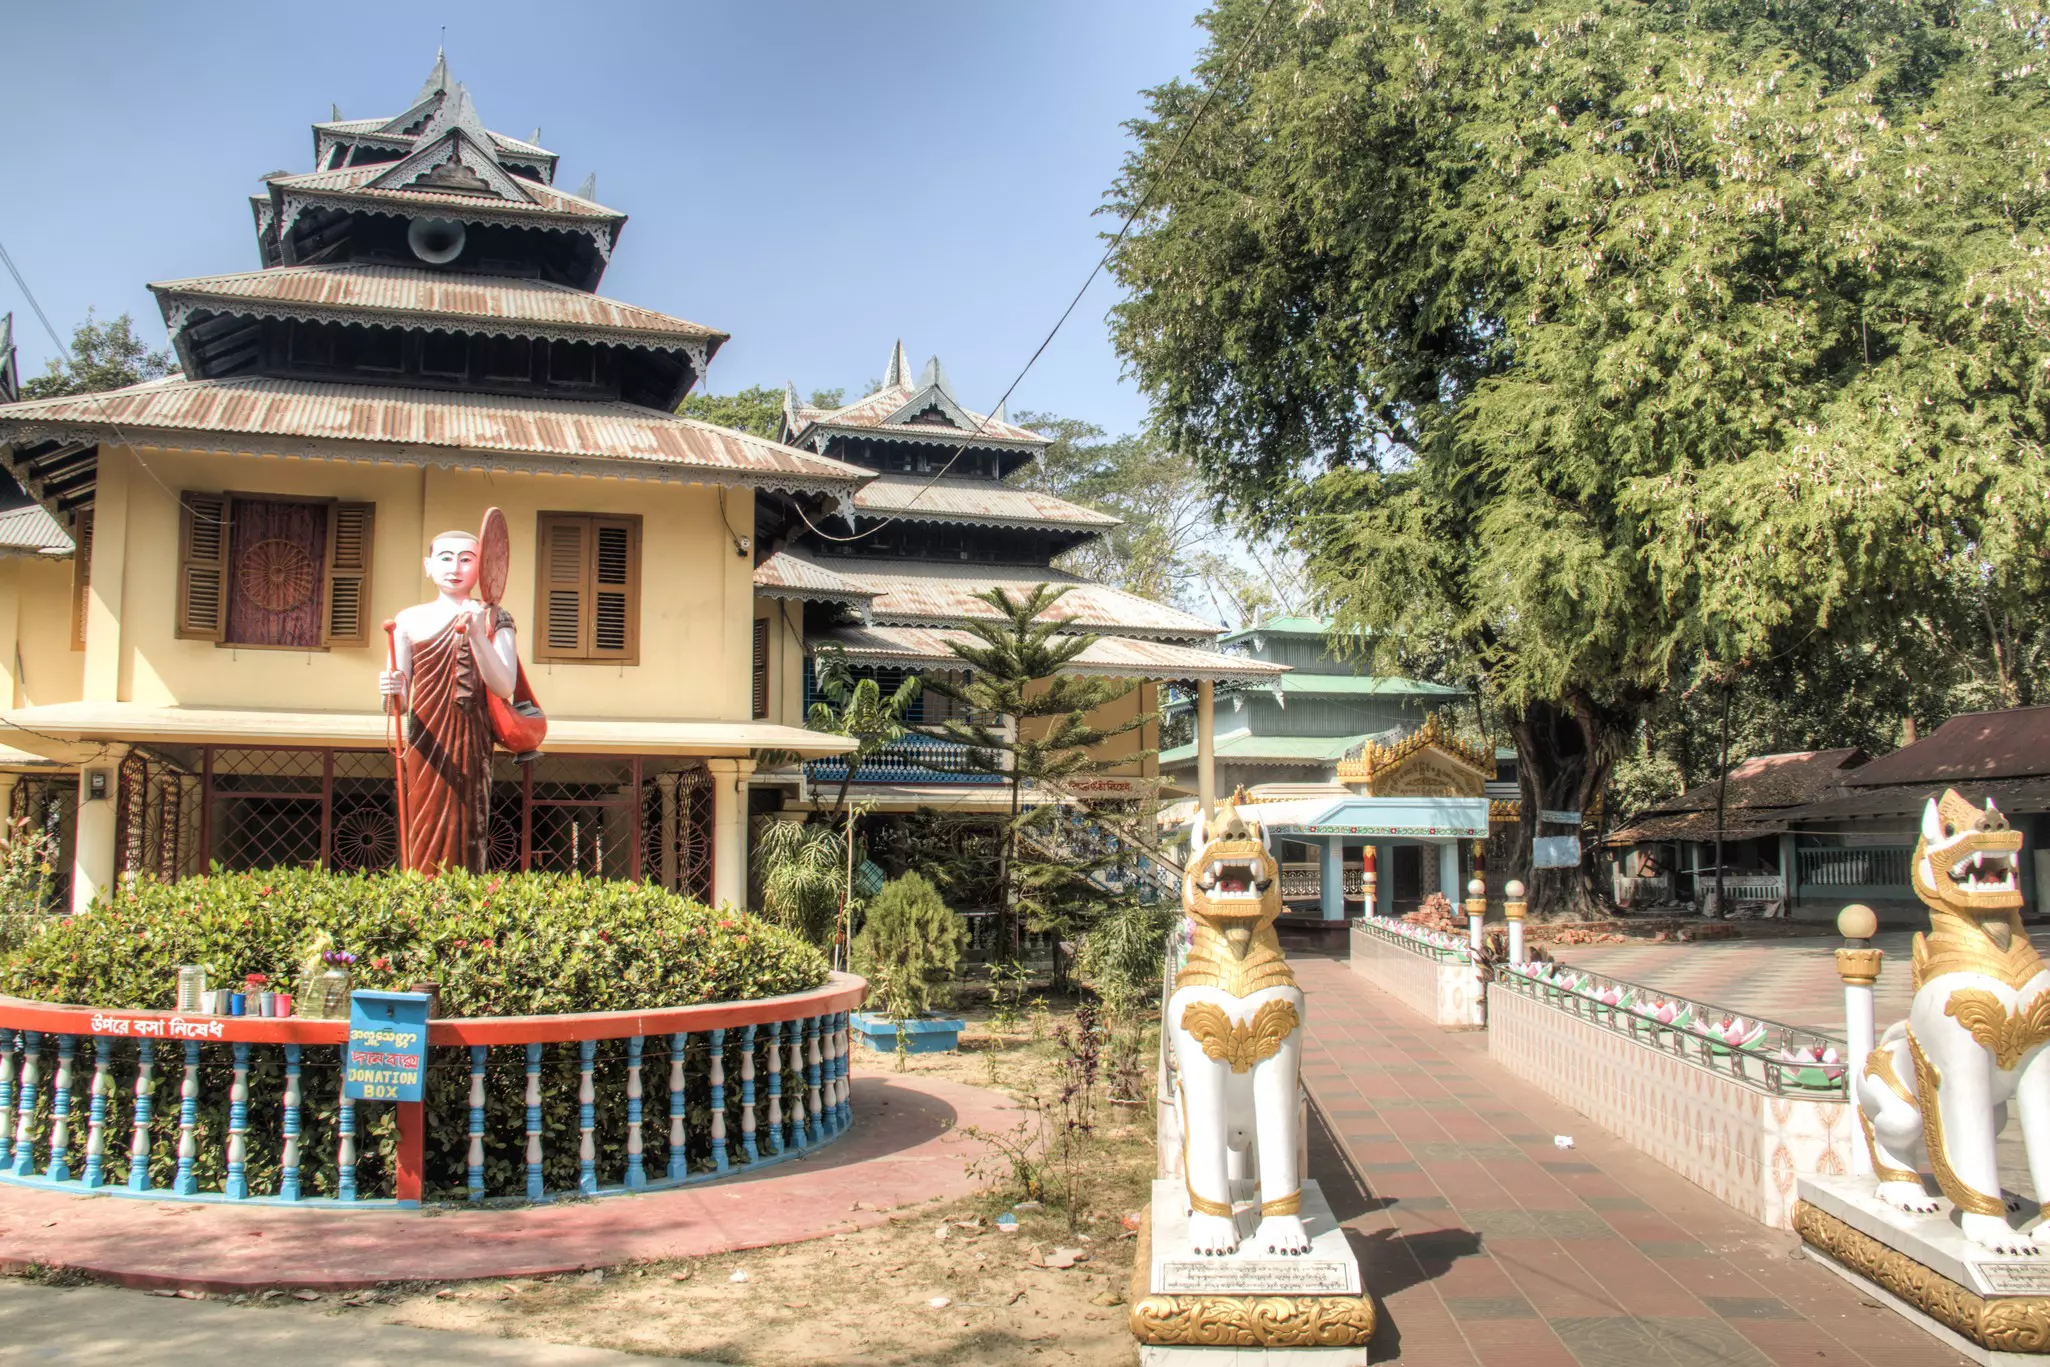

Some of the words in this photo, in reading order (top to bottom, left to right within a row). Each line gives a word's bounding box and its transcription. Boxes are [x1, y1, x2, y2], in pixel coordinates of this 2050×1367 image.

[91, 1014, 129, 1034] উপরে
[134, 1019, 165, 1036] বসা
[168, 1017, 224, 1038] নিষেধ
[347, 1068, 417, 1085] DONATION
[364, 1084, 398, 1098] BOX
